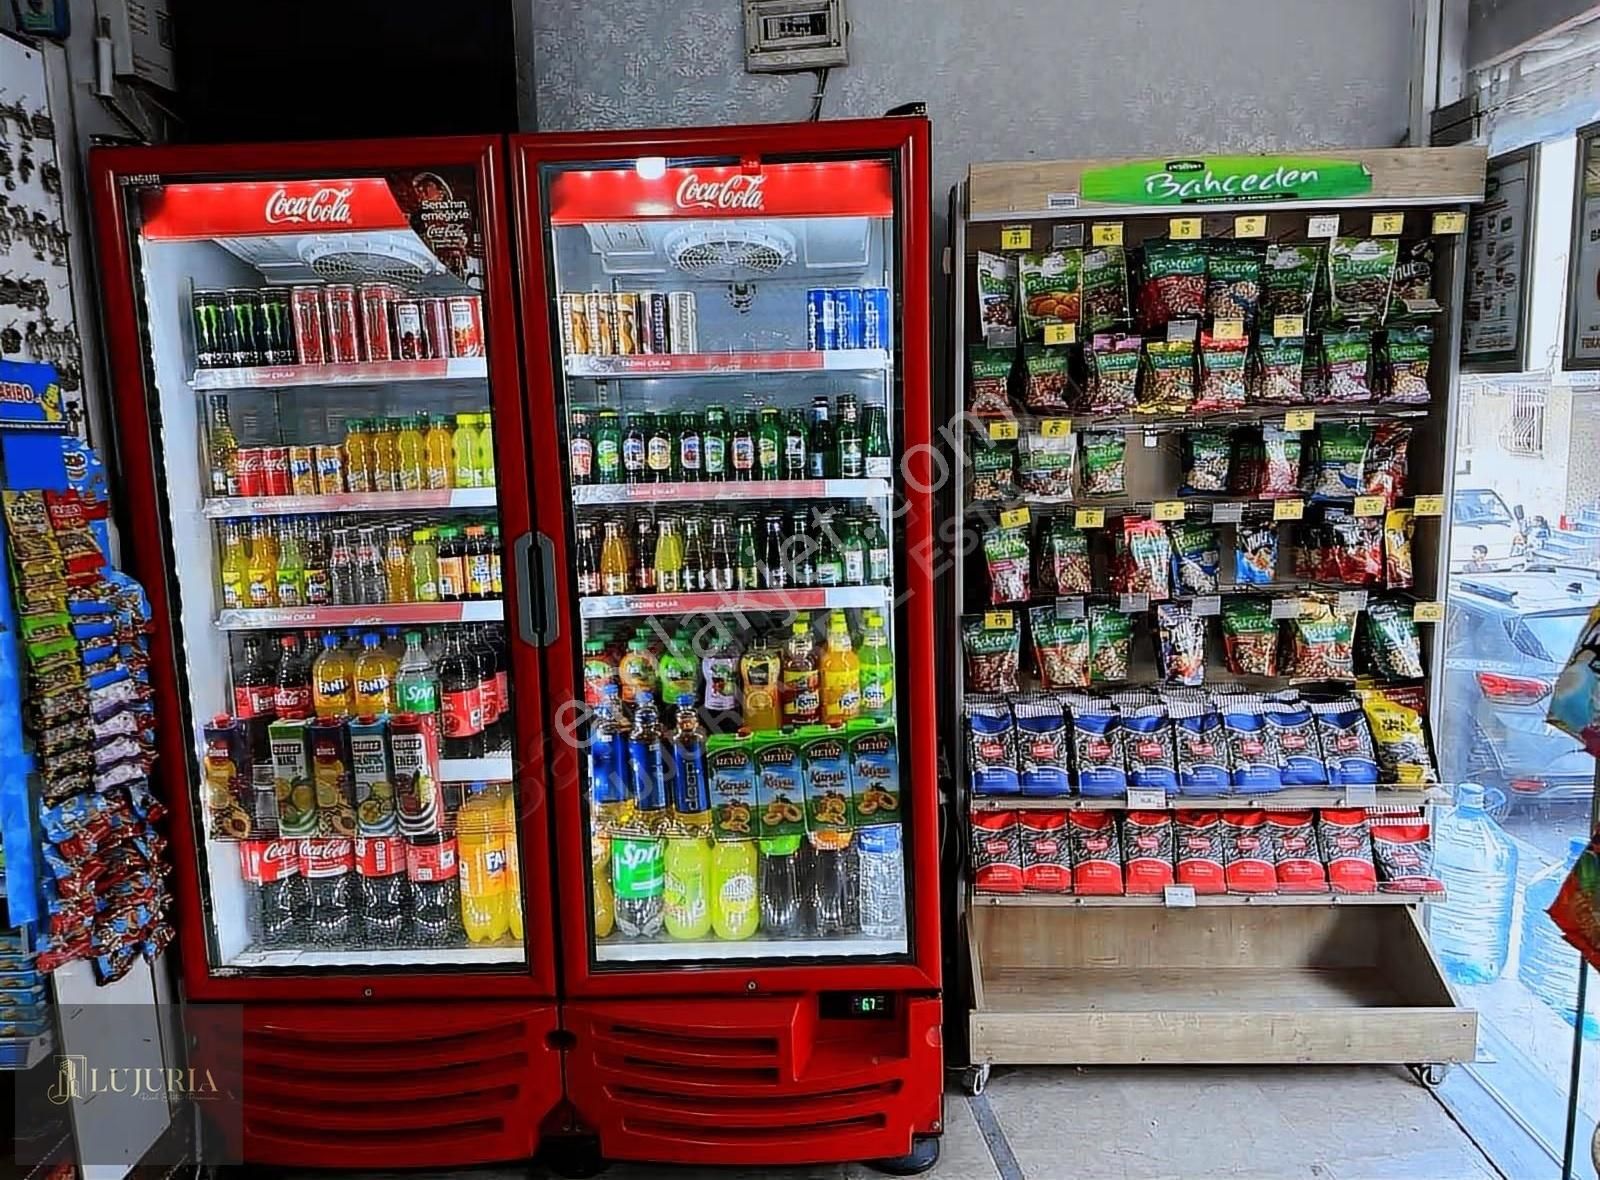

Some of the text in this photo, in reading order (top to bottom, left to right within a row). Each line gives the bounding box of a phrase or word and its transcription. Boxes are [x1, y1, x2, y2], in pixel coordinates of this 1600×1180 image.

[676, 172, 766, 211] Coca-Cola
[1145, 167, 1318, 198] Bahçeden
[264, 187, 353, 225] Coca-Cola
